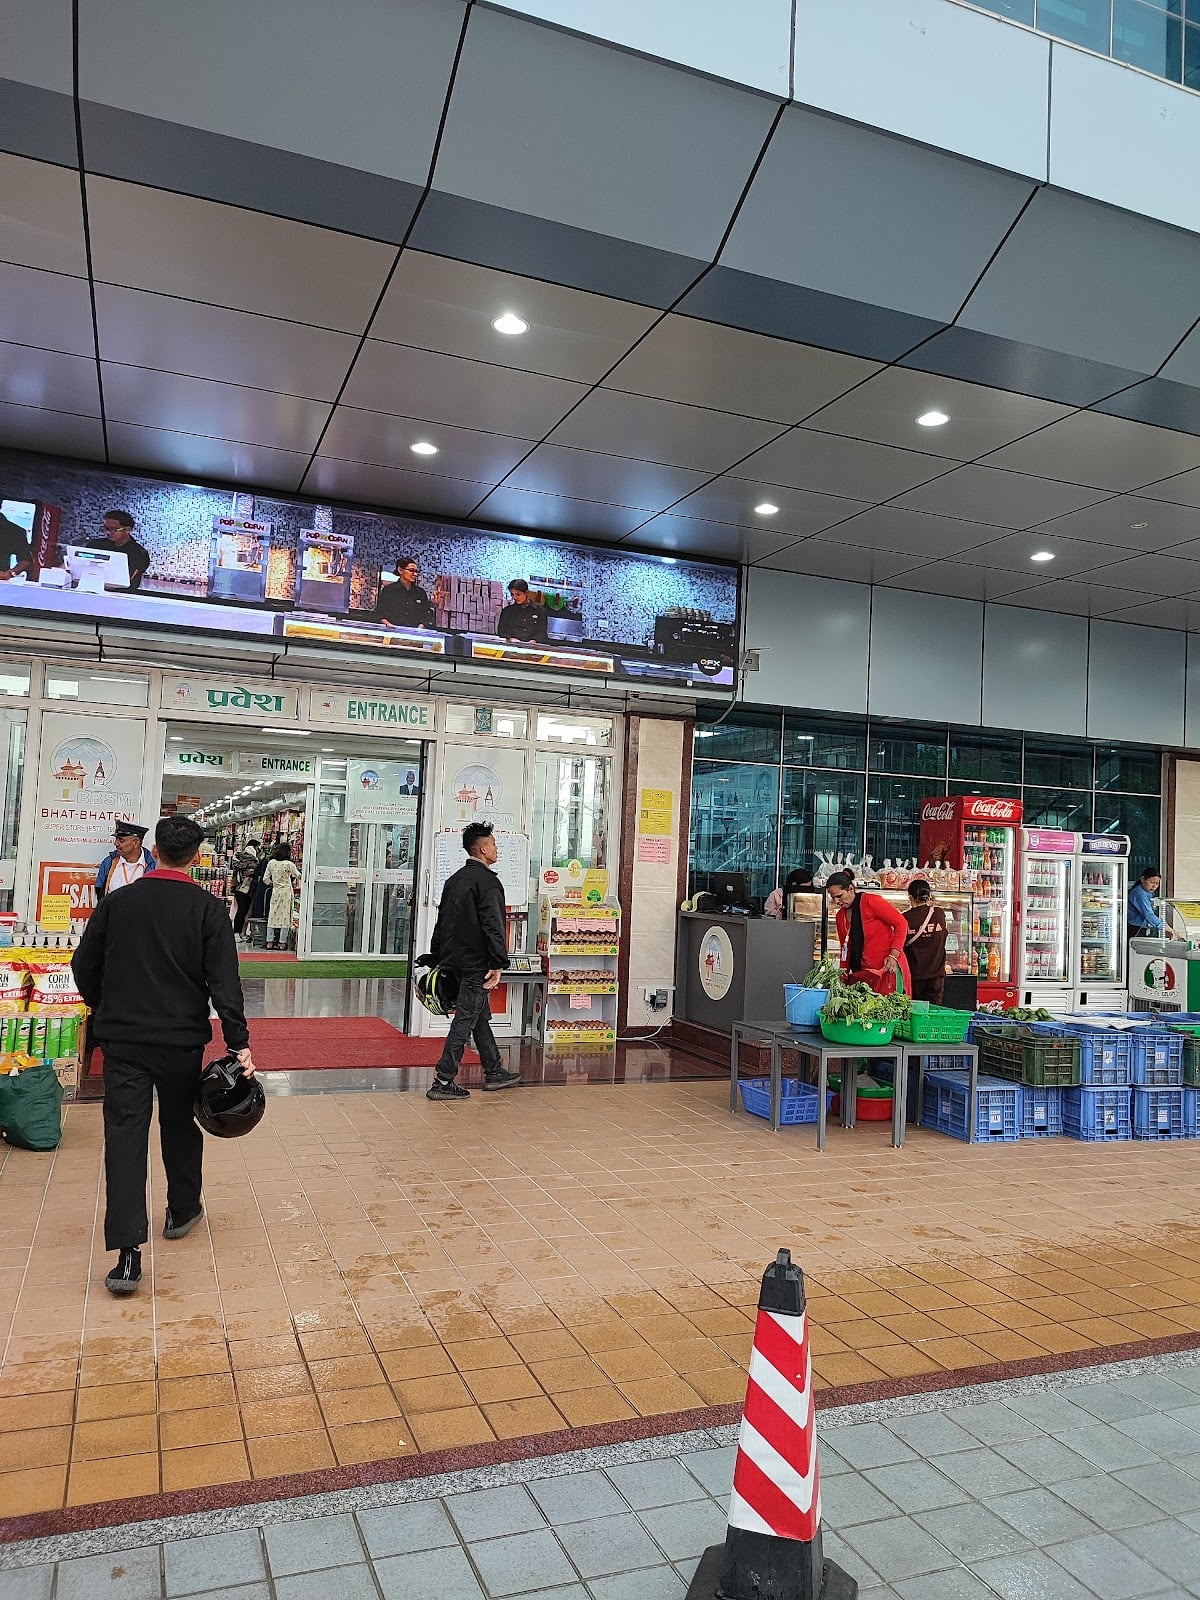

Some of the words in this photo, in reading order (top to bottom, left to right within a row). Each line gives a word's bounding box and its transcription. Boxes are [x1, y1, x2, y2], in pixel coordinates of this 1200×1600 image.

[700, 658, 721, 667] QFX
[205, 686, 286, 712] प्रवेश
[347, 699, 428, 725] ENTRANCE
[178, 750, 224, 766] प्रवेश
[261, 757, 311, 772] ENTRANCE
[77, 790, 132, 807] BBSM
[41, 808, 135, 822] BHAT-BHATENI
[922, 801, 956, 821] Coca-Cola
[970, 799, 1015, 818] Coca-Cola
[48, 974, 70, 984] CORN
[41, 994, 63, 1004] 25%
